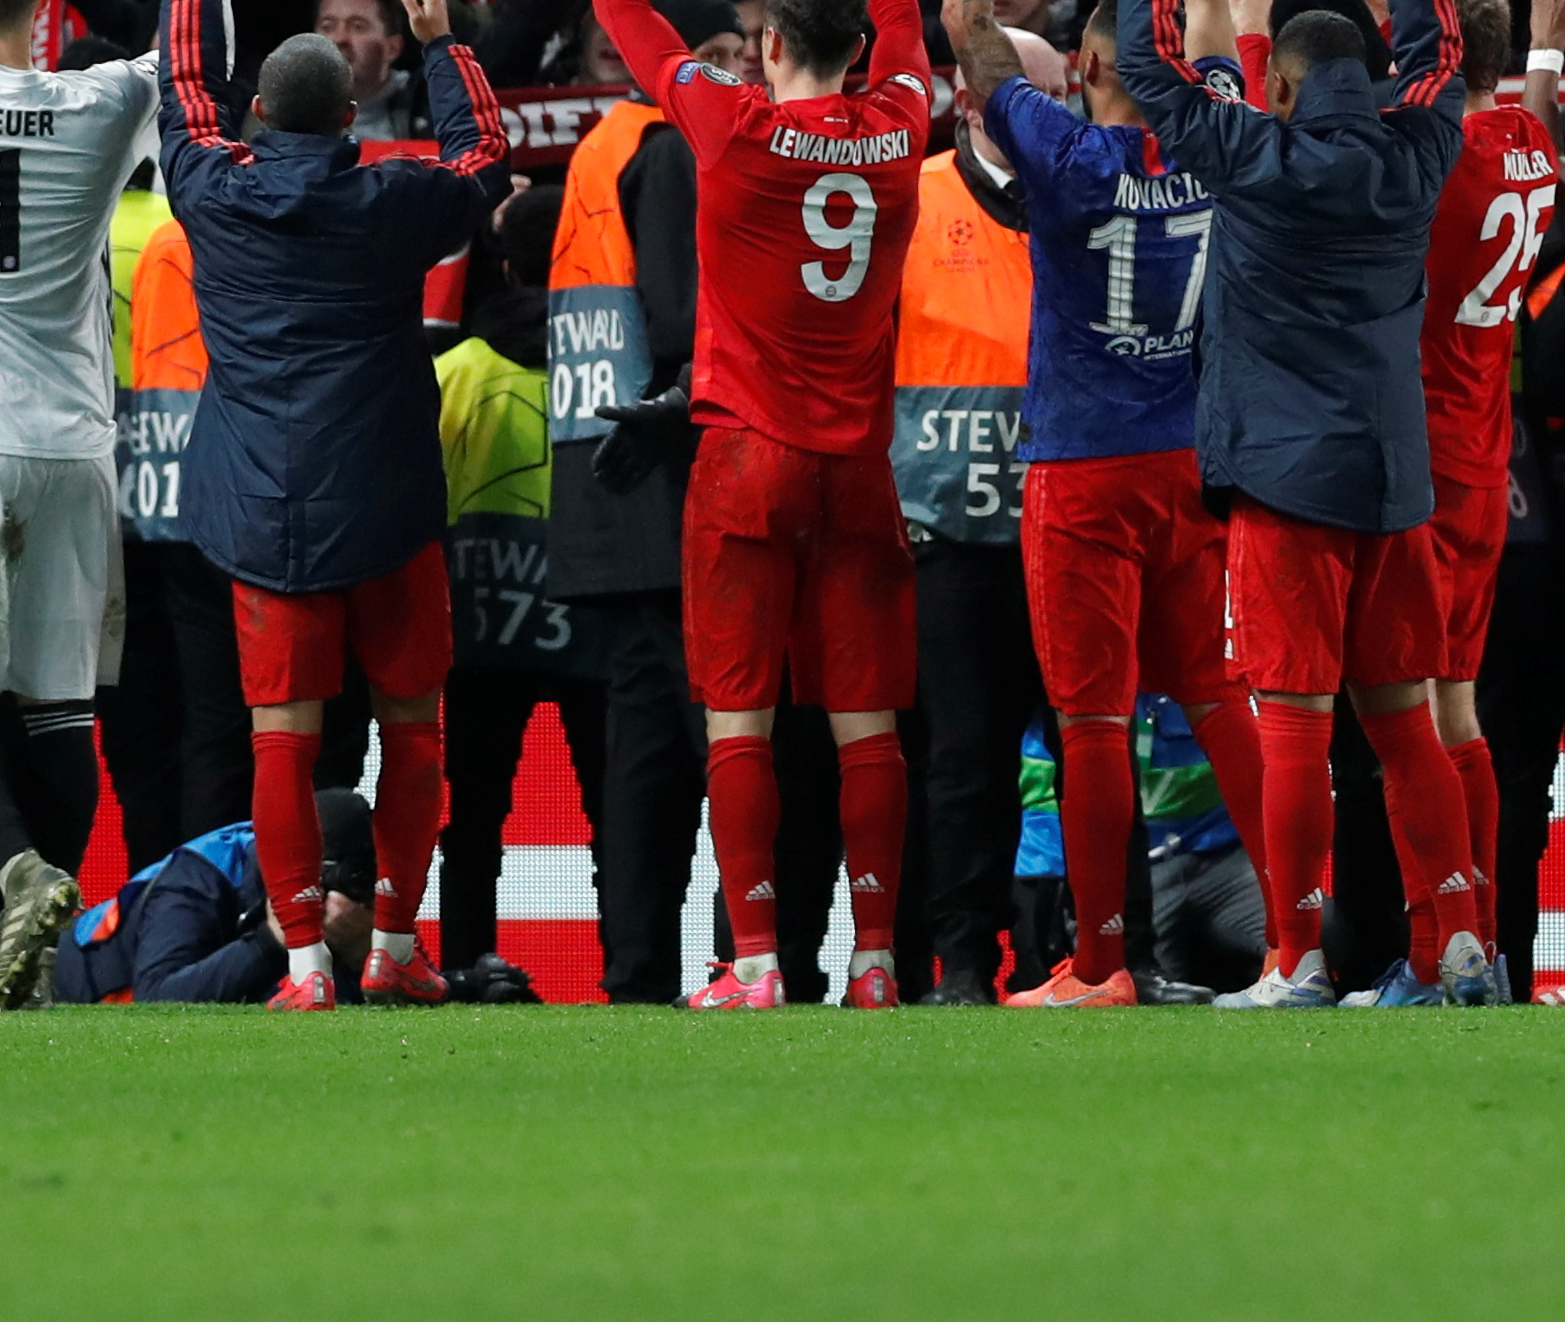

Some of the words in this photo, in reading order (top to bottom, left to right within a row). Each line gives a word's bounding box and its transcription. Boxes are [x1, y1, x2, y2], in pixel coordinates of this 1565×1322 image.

[770, 125, 910, 166] LEWANDOWSKI
[800, 173, 878, 303] 9
[1087, 208, 1214, 337] 17
[1454, 184, 1557, 329] 25
[552, 359, 617, 420] 018
[1144, 330, 1196, 354] PLAN
